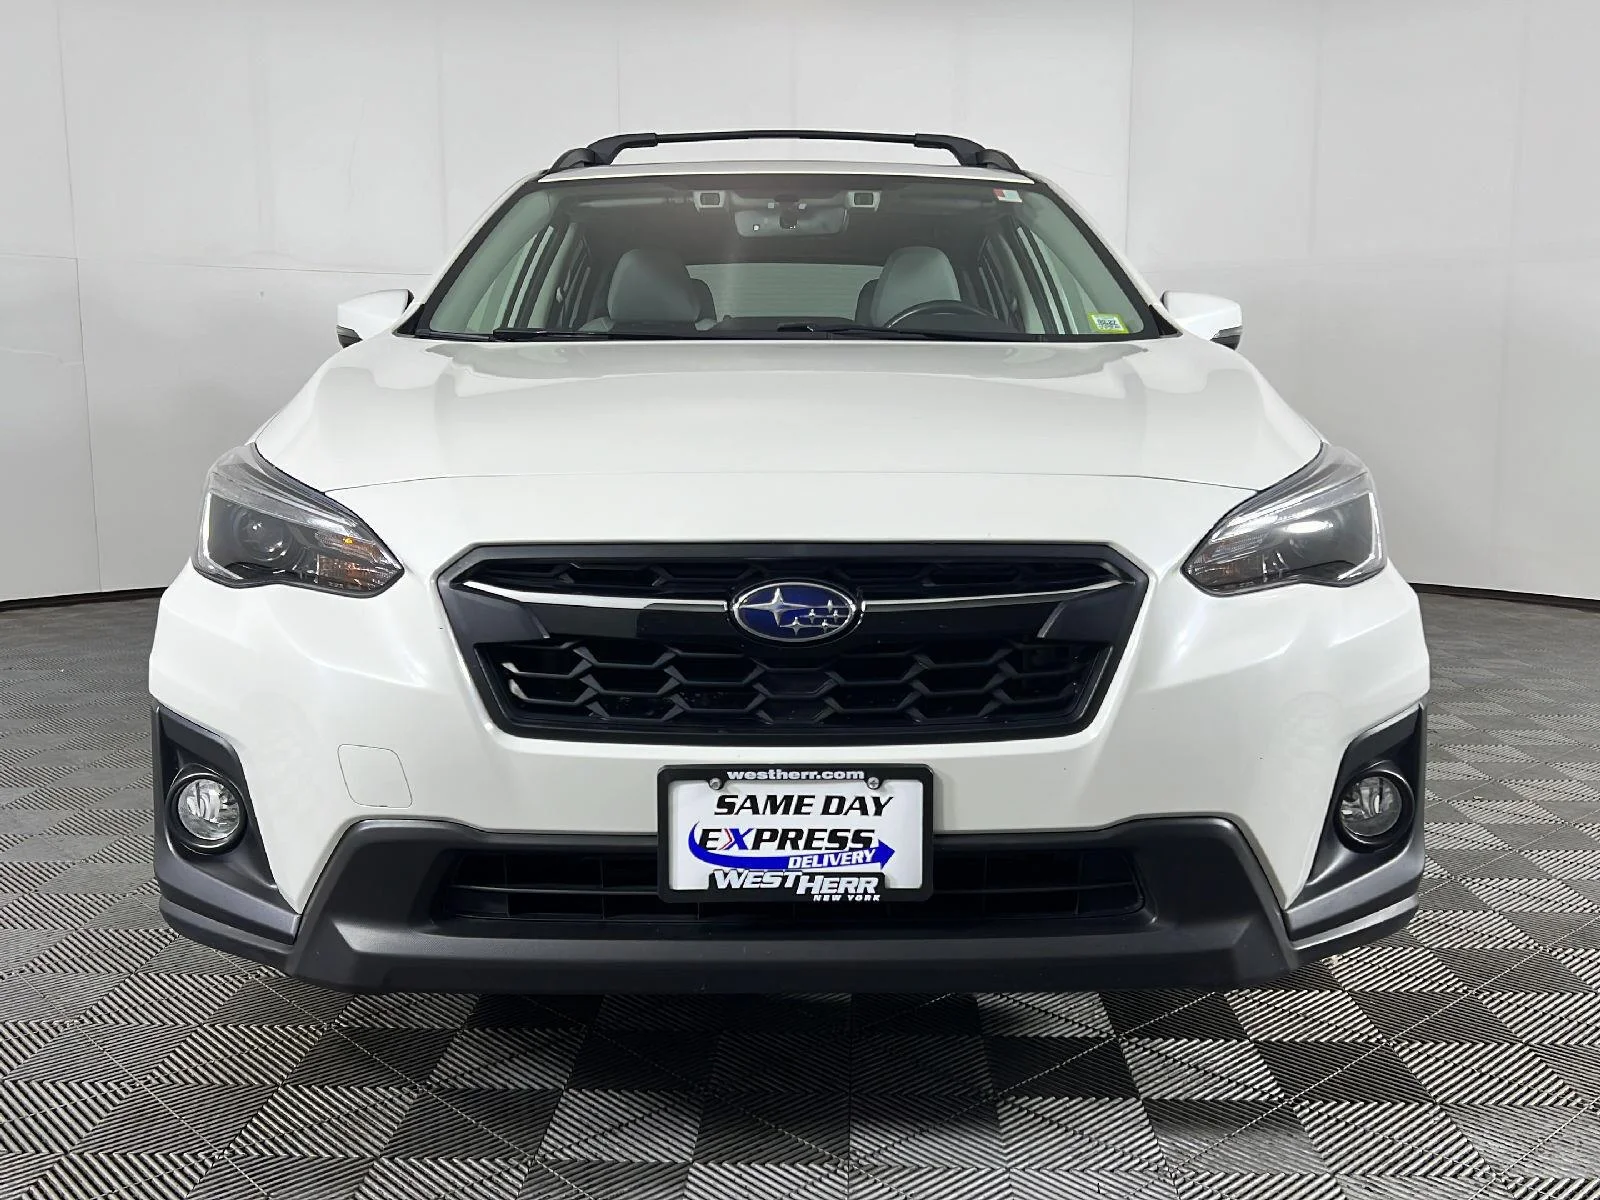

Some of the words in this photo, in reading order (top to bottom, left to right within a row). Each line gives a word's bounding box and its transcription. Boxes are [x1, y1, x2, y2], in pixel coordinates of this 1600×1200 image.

[727, 769, 865, 780] westherr.com
[714, 794, 816, 816] SAME
[820, 796, 894, 816] DAY
[699, 828, 876, 851] EXPRESS
[787, 848, 876, 870] DELIVERY
[812, 894, 842, 902] NEW
[847, 894, 881, 902] YORK
